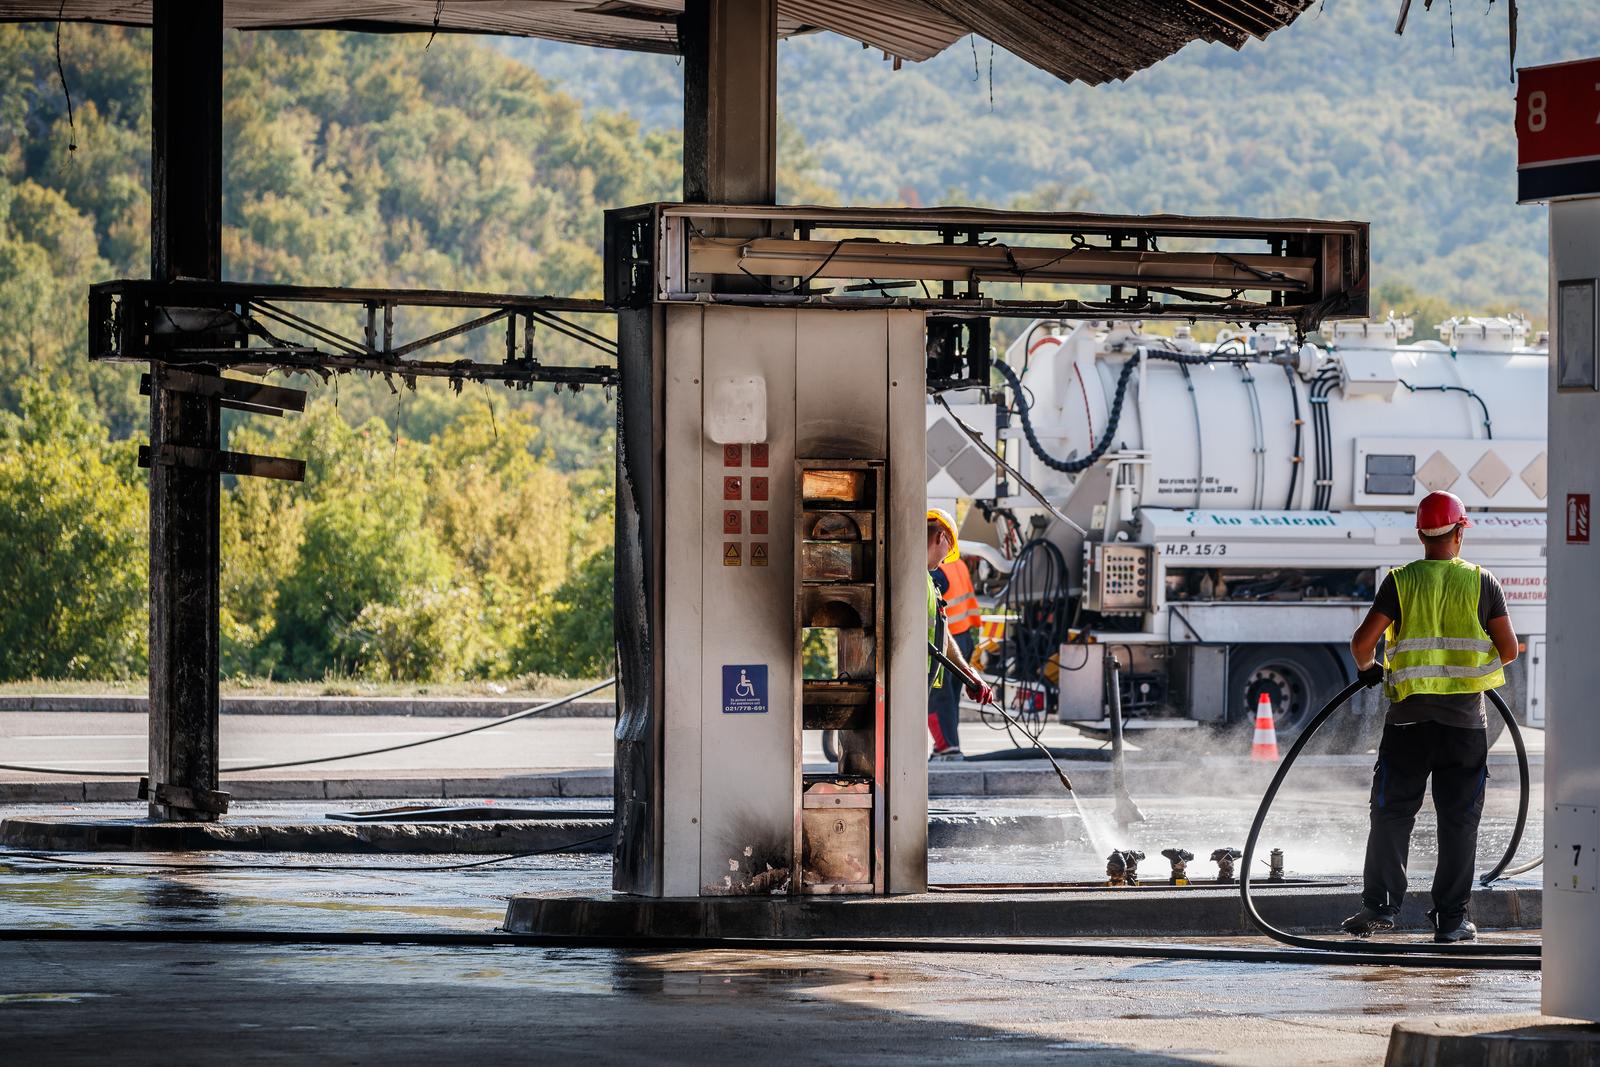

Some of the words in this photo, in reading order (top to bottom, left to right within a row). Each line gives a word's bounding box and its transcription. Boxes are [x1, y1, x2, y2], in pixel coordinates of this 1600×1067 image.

[1528, 90, 1547, 132] 8
[1249, 514, 1337, 526] sistemi
[1165, 544, 1190, 555] H.P.
[1195, 544, 1226, 555] 15/3
[1501, 577, 1541, 585] KEMIJSKO
[1572, 845, 1581, 866] 7
